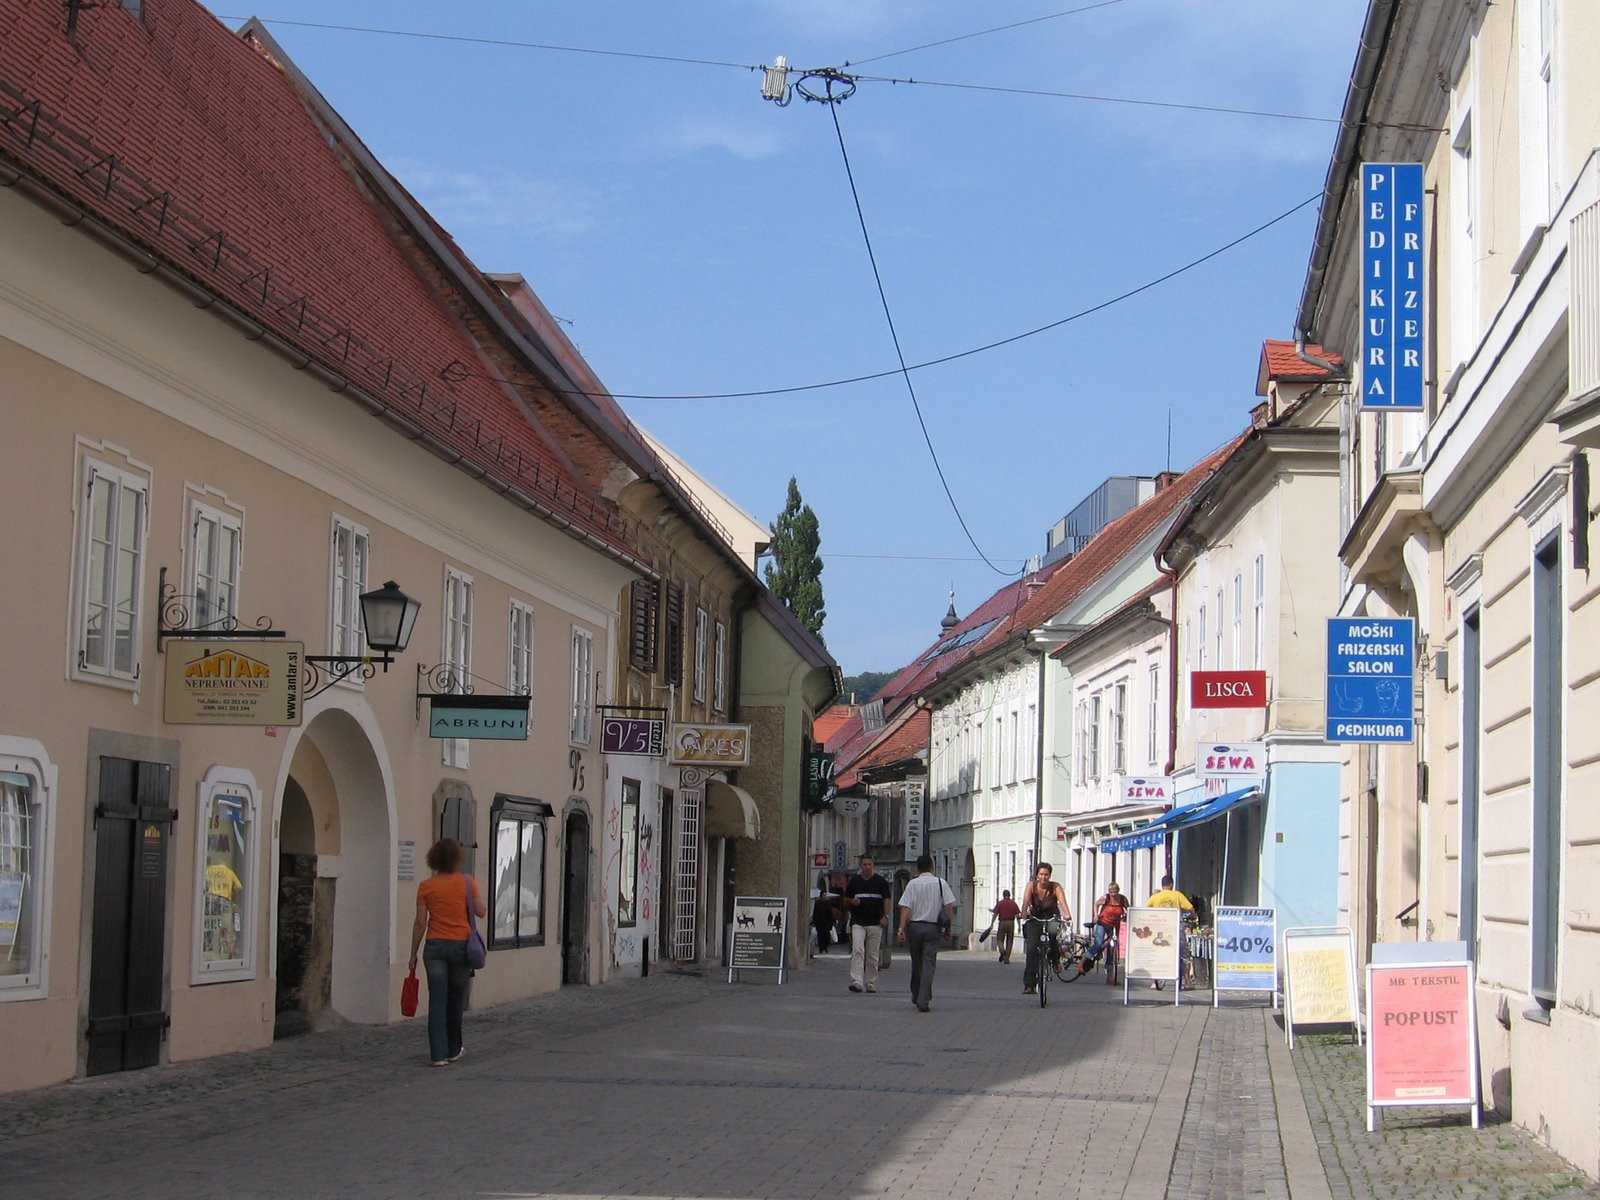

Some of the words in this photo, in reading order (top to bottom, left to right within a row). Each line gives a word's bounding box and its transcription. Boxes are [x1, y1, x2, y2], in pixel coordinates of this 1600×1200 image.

[1368, 173, 1386, 395] PEDIKURA
[1403, 203, 1420, 368] FRIZER
[1348, 622, 1394, 638] MOŠKI
[1337, 643, 1404, 656] FRIZERSKI
[185, 653, 270, 679] ANTAR
[1347, 661, 1394, 674] SALON
[286, 651, 299, 720] www.antar.si
[1205, 681, 1254, 697] LISCA
[435, 718, 523, 729] ABRUNI
[1336, 723, 1404, 737] PEDIKURA
[1205, 755, 1255, 769] SEWA
[1127, 786, 1165, 798] SEWA
[1389, 977, 1406, 987] MB
